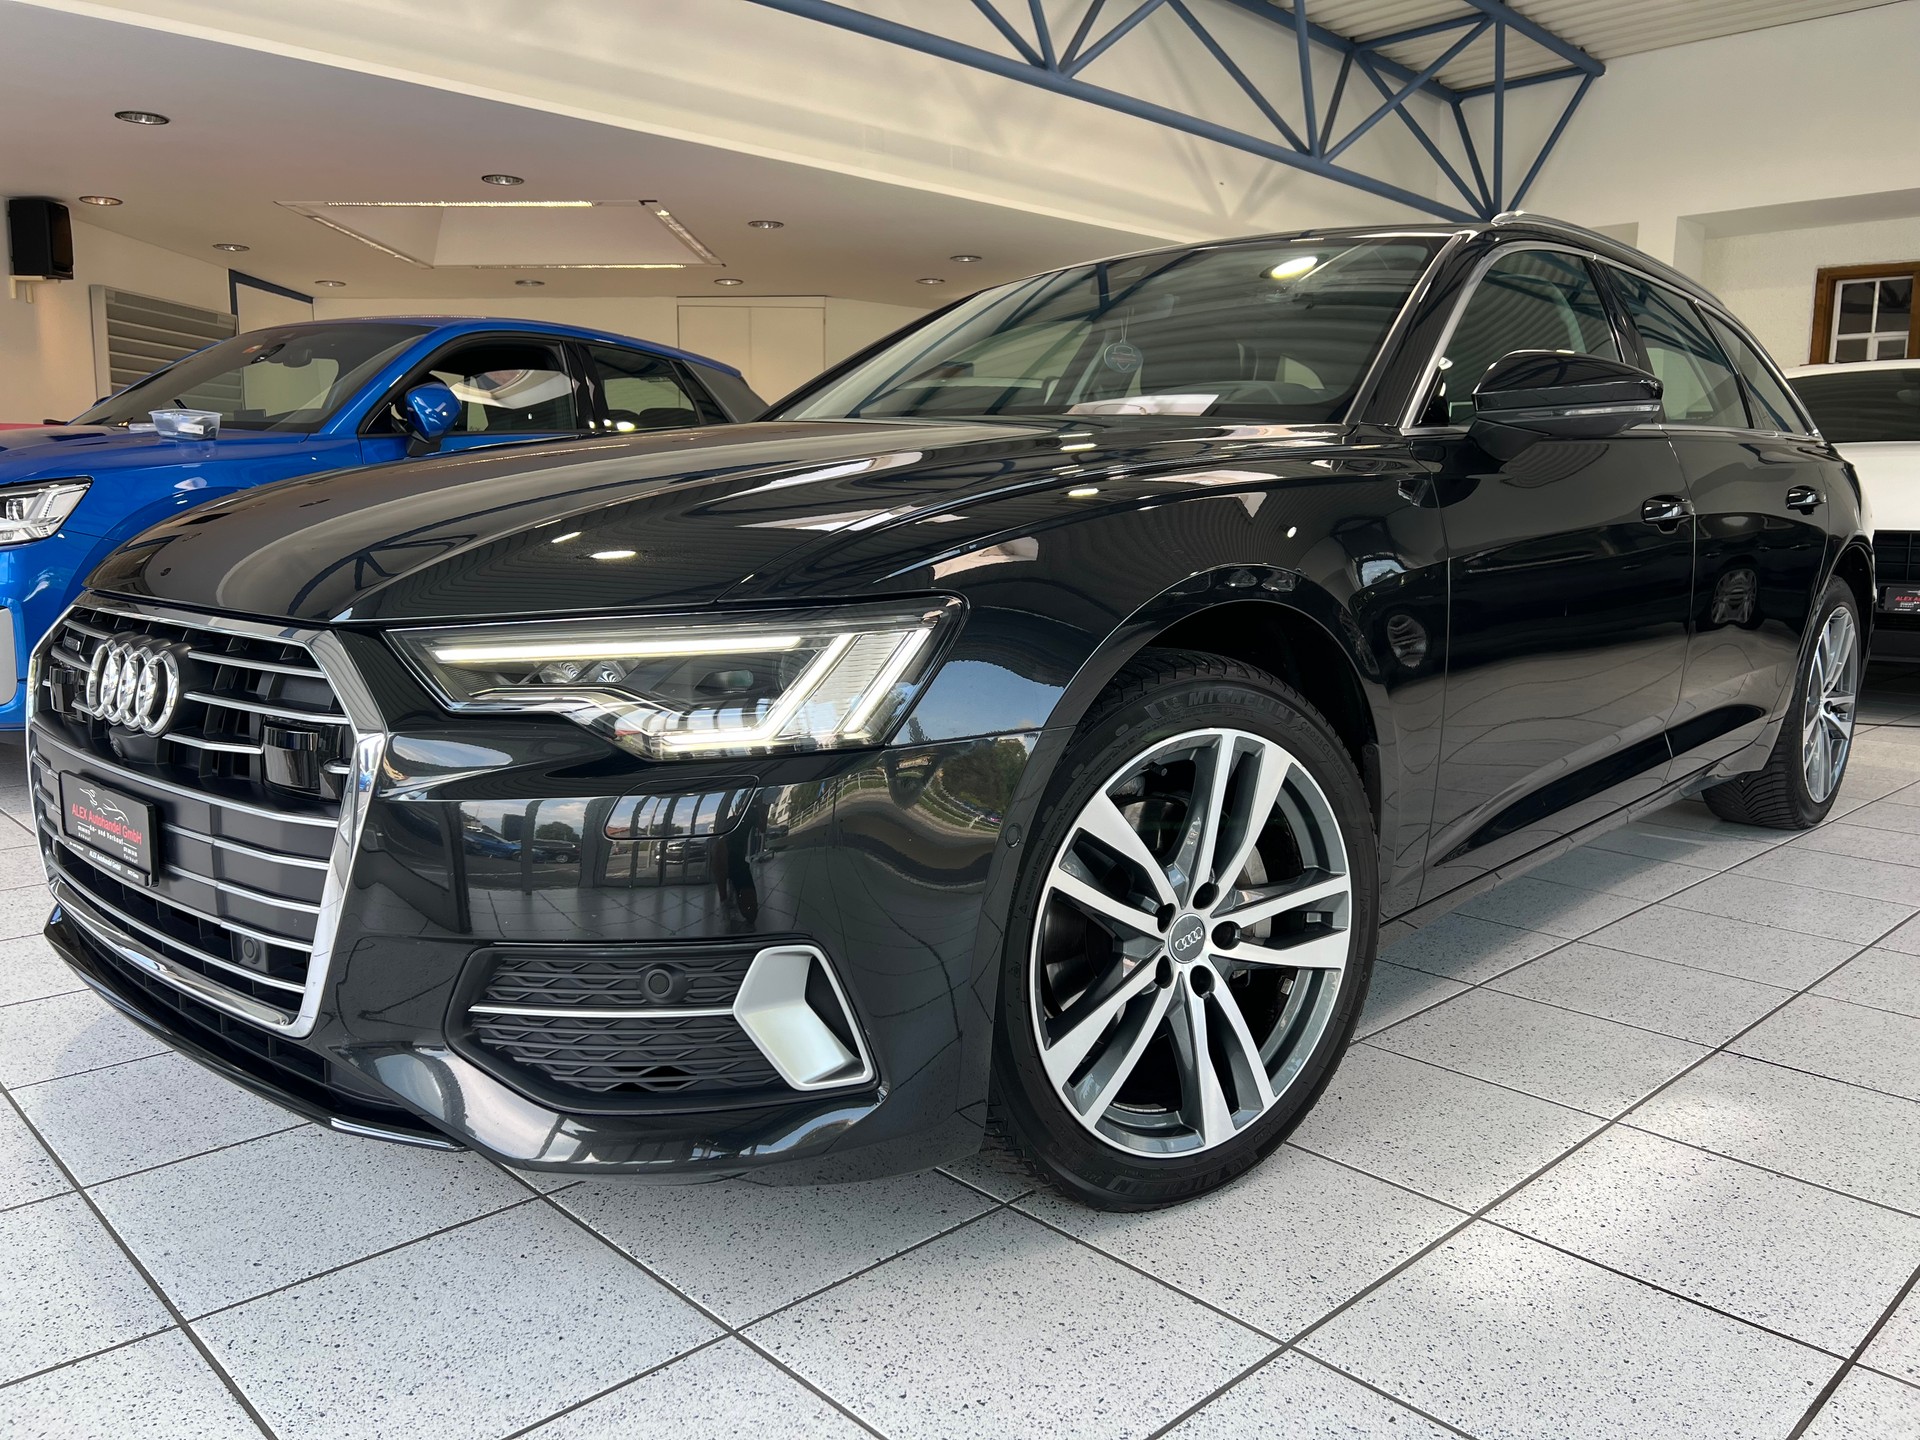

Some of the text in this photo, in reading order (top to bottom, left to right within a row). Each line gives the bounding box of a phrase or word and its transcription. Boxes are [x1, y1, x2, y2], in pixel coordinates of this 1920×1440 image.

[1187, 690, 1291, 720] MICHELIN
[71, 803, 88, 821] ALEX
[88, 810, 122, 836] Autohandel
[122, 824, 143, 846] GmbH
